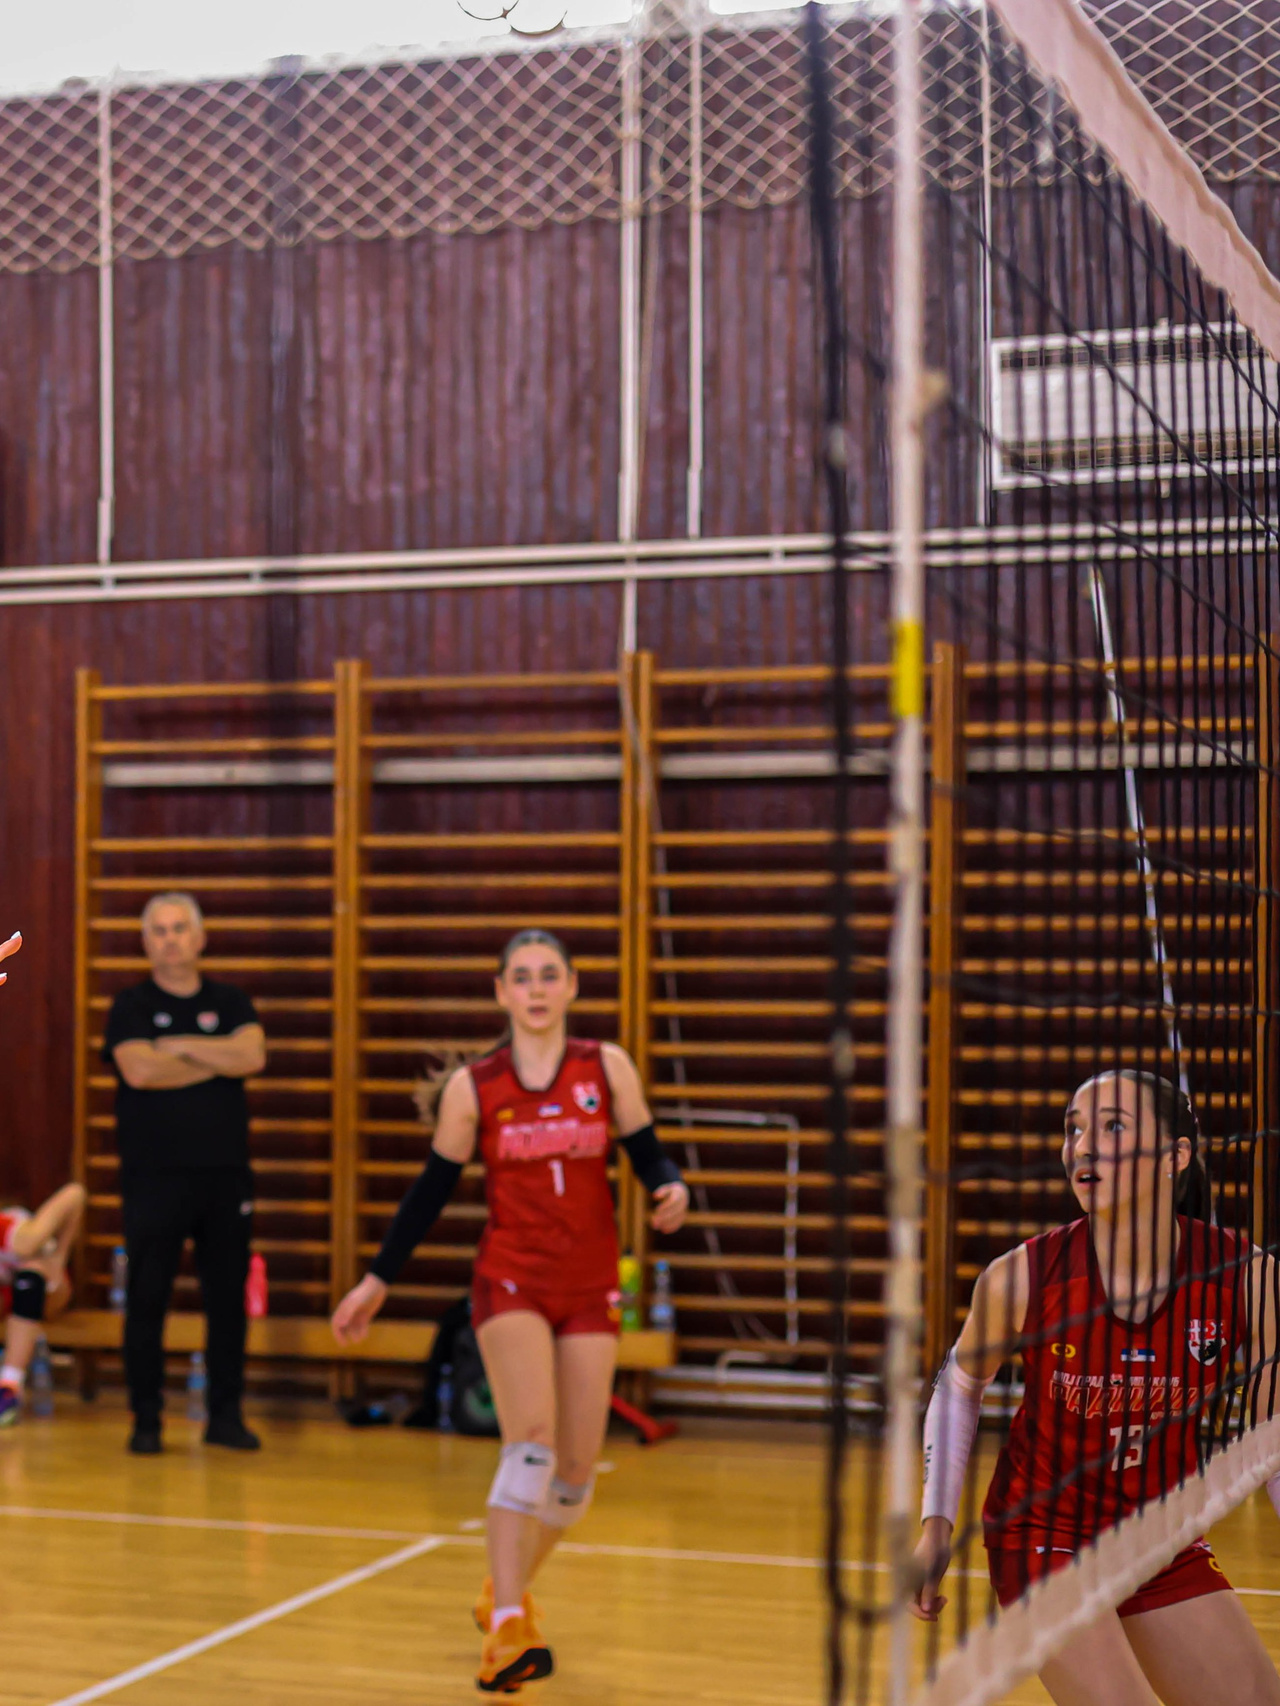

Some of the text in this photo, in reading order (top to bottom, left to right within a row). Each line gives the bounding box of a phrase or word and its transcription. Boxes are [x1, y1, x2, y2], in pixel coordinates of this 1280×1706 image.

[549, 1160, 565, 1196] 1
[1129, 1376, 1152, 1387] МО
[1109, 1425, 1146, 1472] 13
